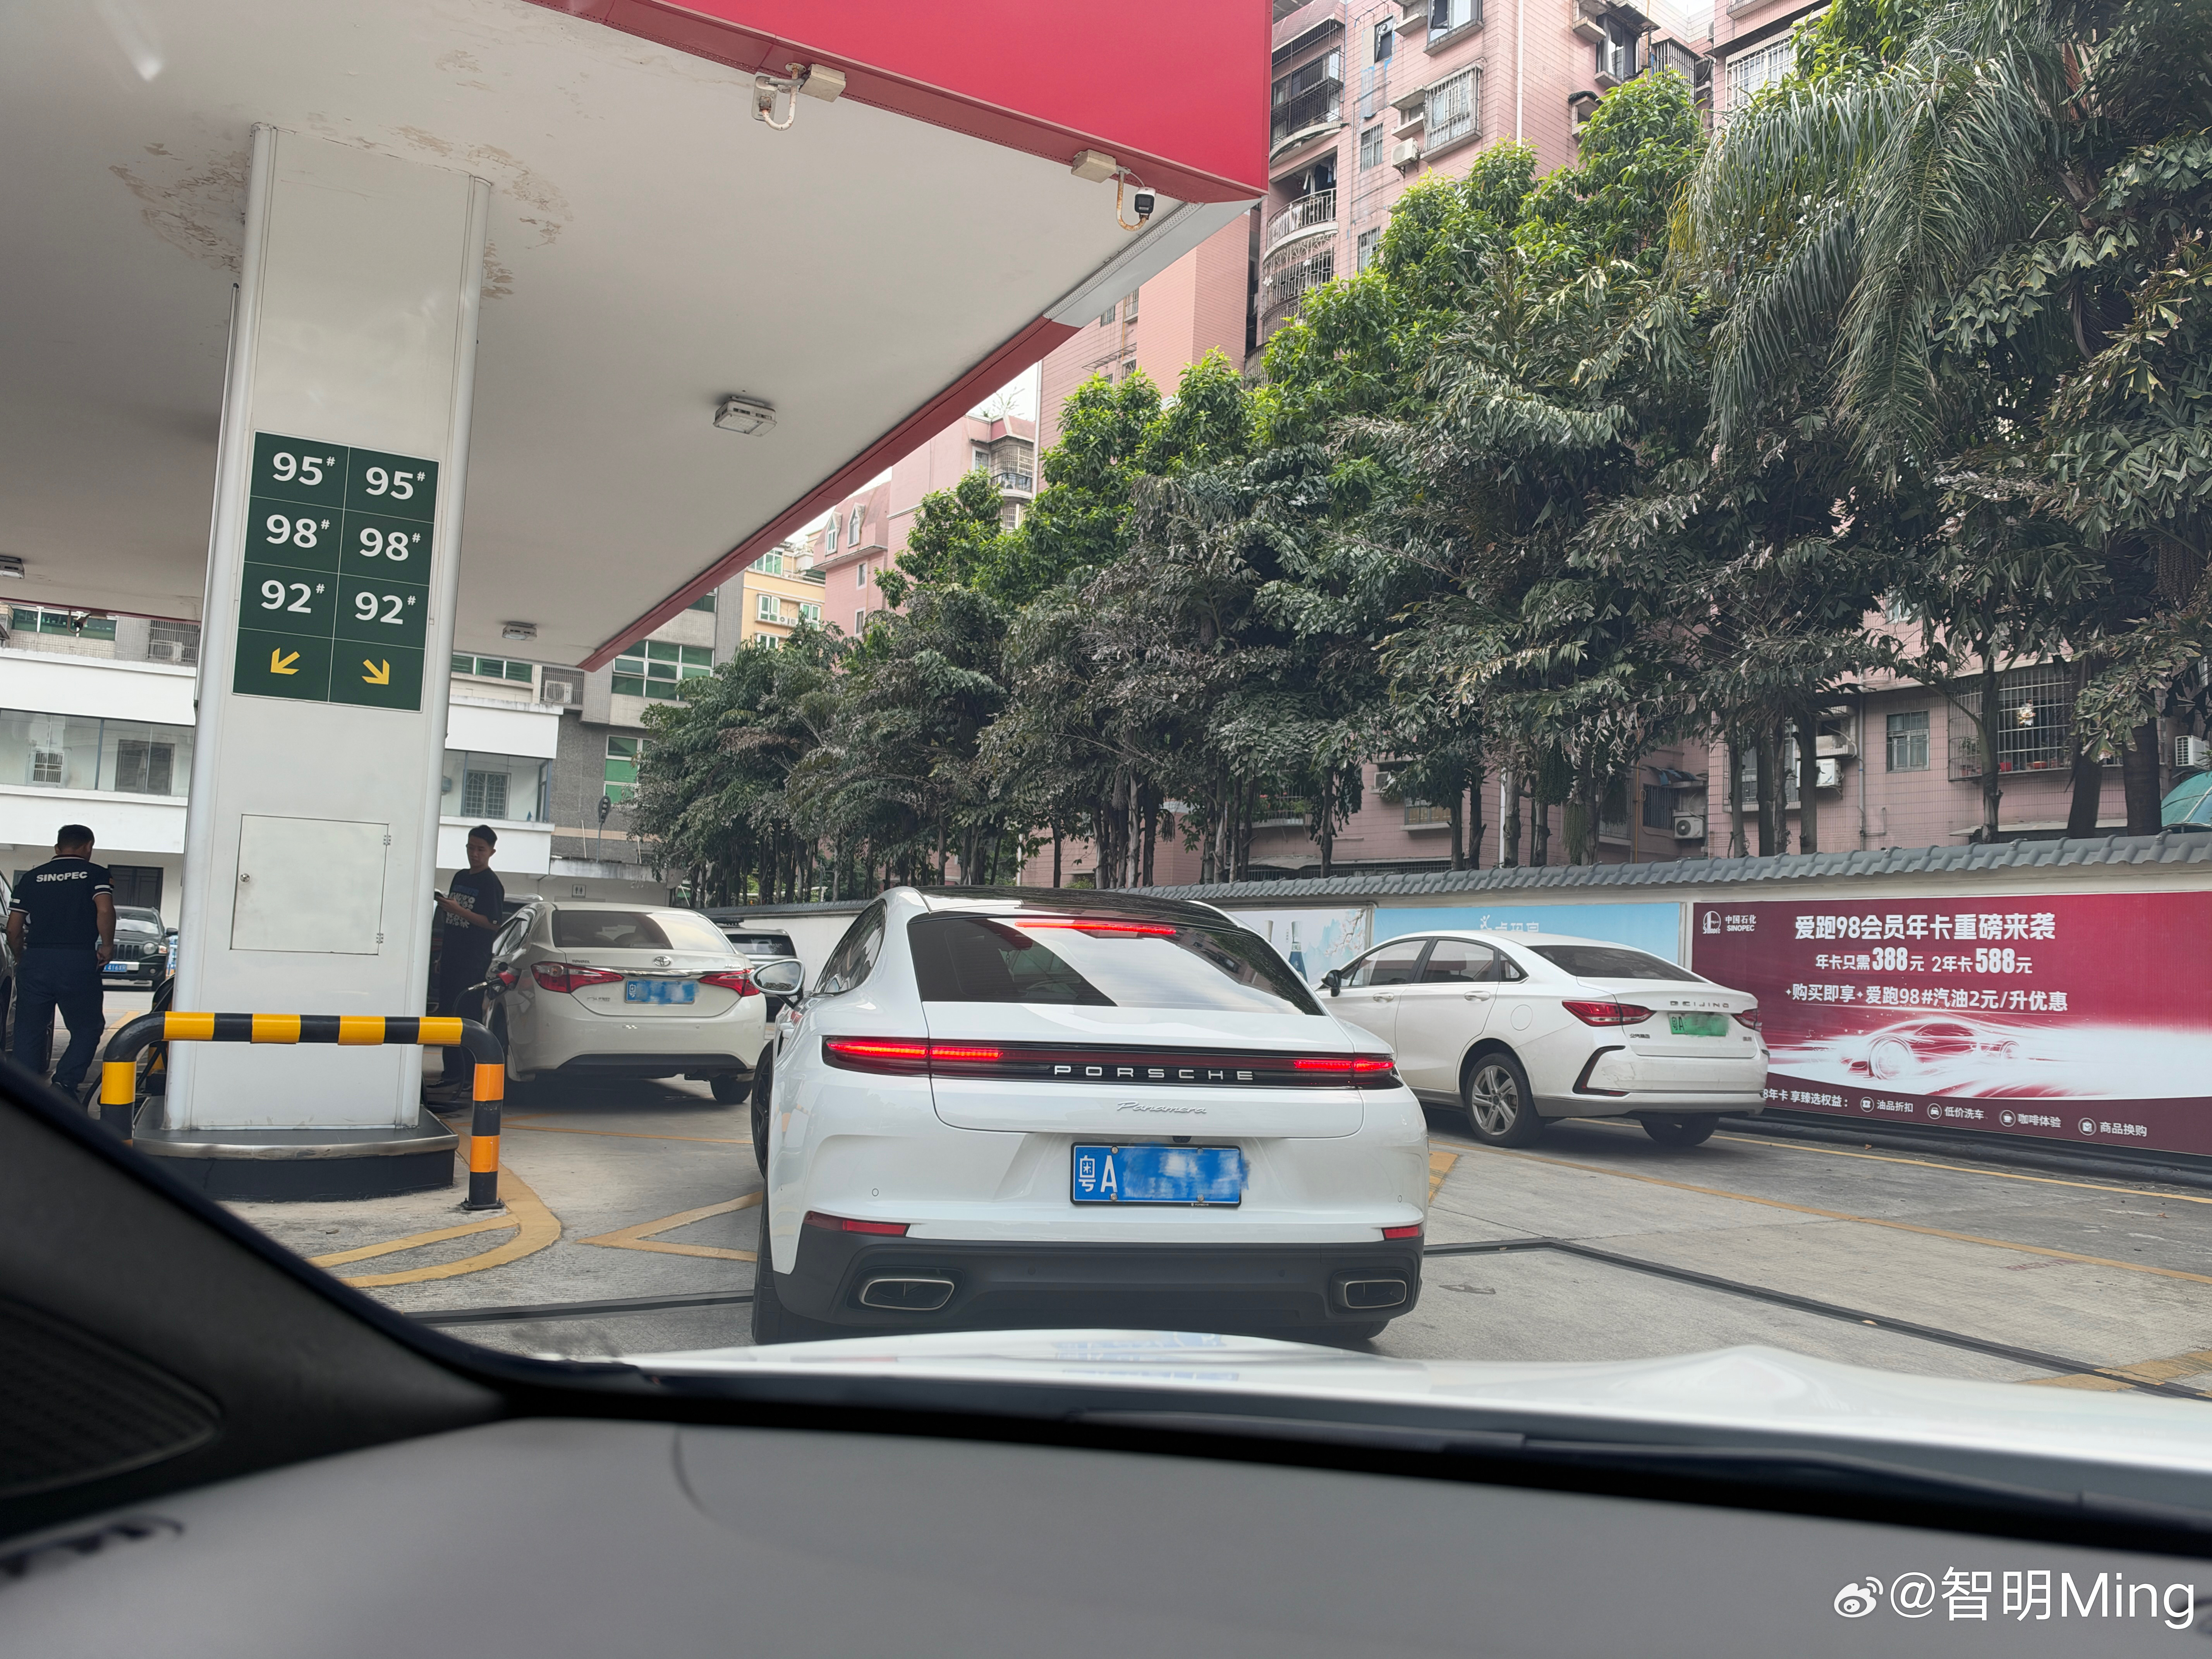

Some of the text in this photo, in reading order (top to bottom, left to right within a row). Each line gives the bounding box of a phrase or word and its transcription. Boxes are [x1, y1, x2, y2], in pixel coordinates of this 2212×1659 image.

[36, 871, 88, 883] SINOPEC
[1725, 914, 1757, 924] 中国石化
[1795, 912, 2056, 940] 爱跑98会员年卡重磅来袭
[1815, 947, 2033, 974] 年卡只需388元 2年卡588元
[1792, 983, 1856, 1003] 购买即享
[1054, 1065, 1253, 1080] PORSCHE
[1117, 1101, 1207, 1114] Panamera
[1877, 1099, 1913, 1113] 油品折扣
[1944, 1106, 1985, 1120] 低价洗车
[2018, 1113, 2061, 1128] 咖啡体验
[2100, 1121, 2147, 1137] 商品换购
